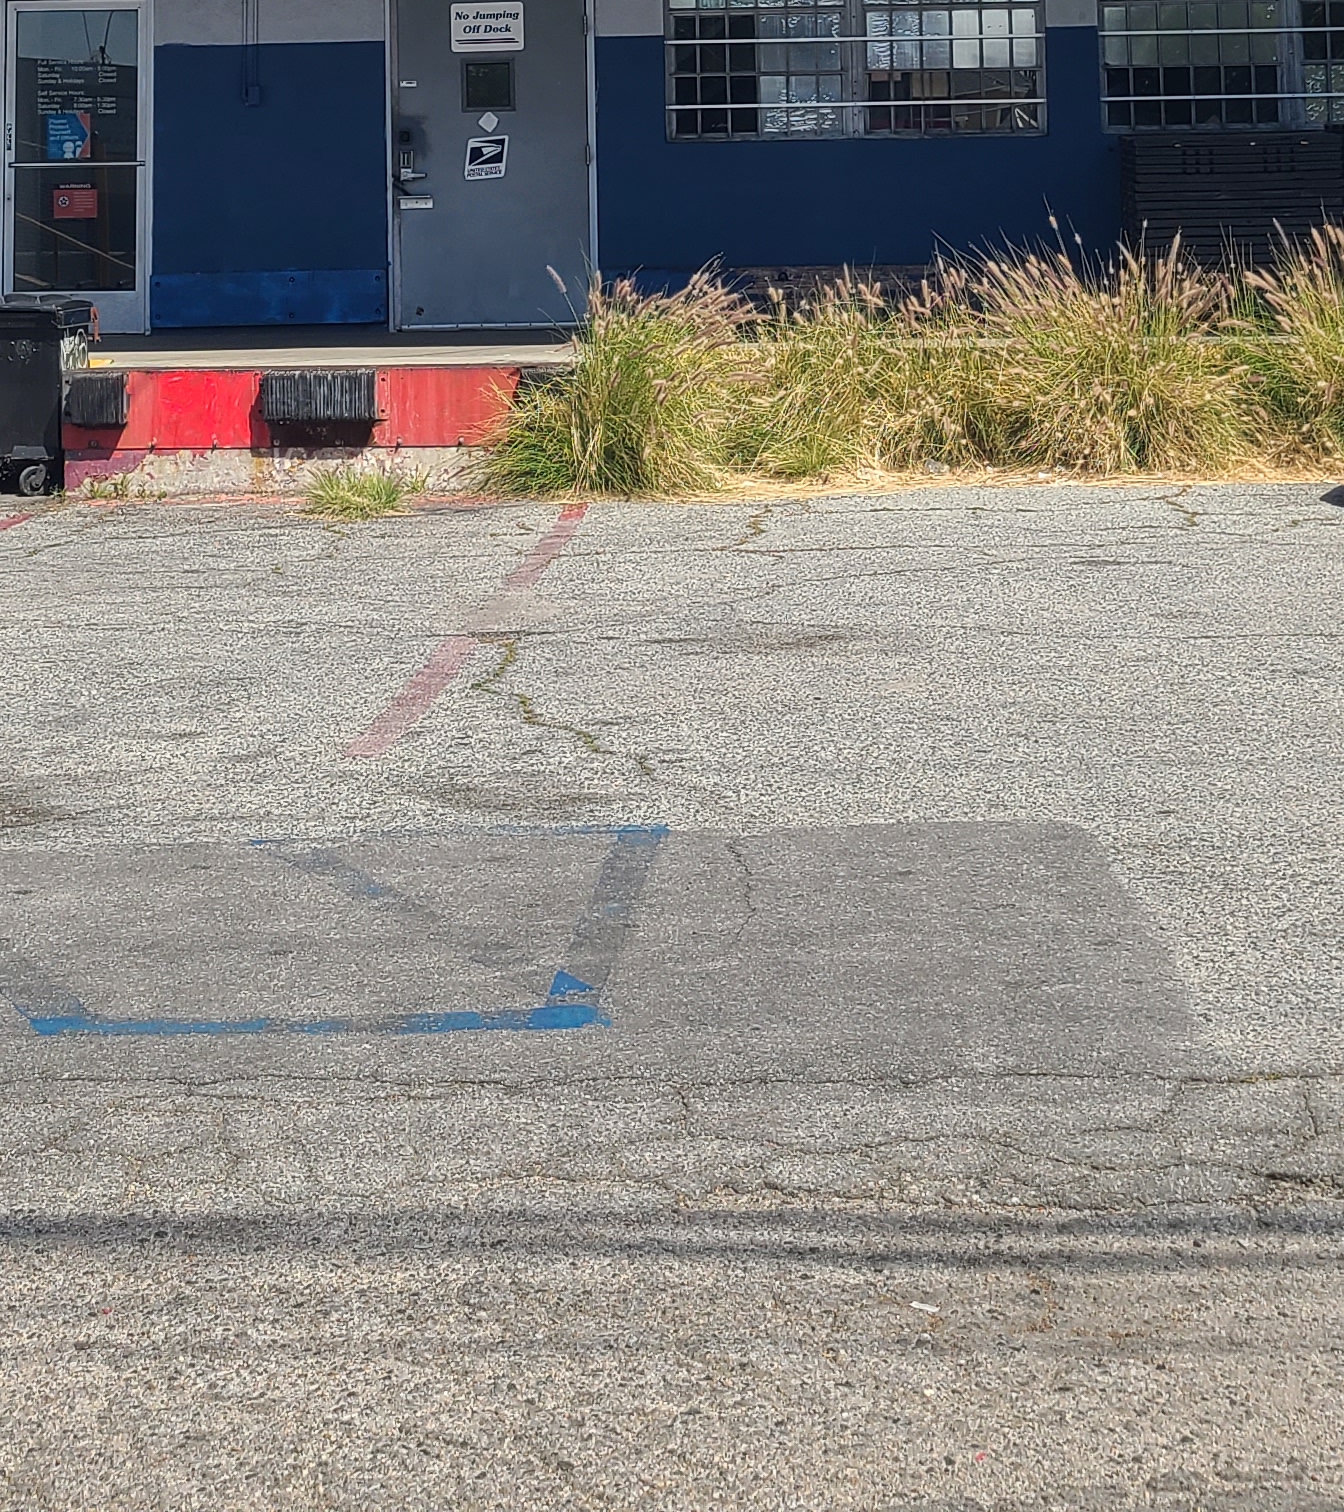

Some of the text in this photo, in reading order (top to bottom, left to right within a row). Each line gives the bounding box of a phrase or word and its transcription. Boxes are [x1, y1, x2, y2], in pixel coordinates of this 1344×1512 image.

[454, 10, 519, 21] No Jumping
[463, 24, 512, 34] Off Dock
